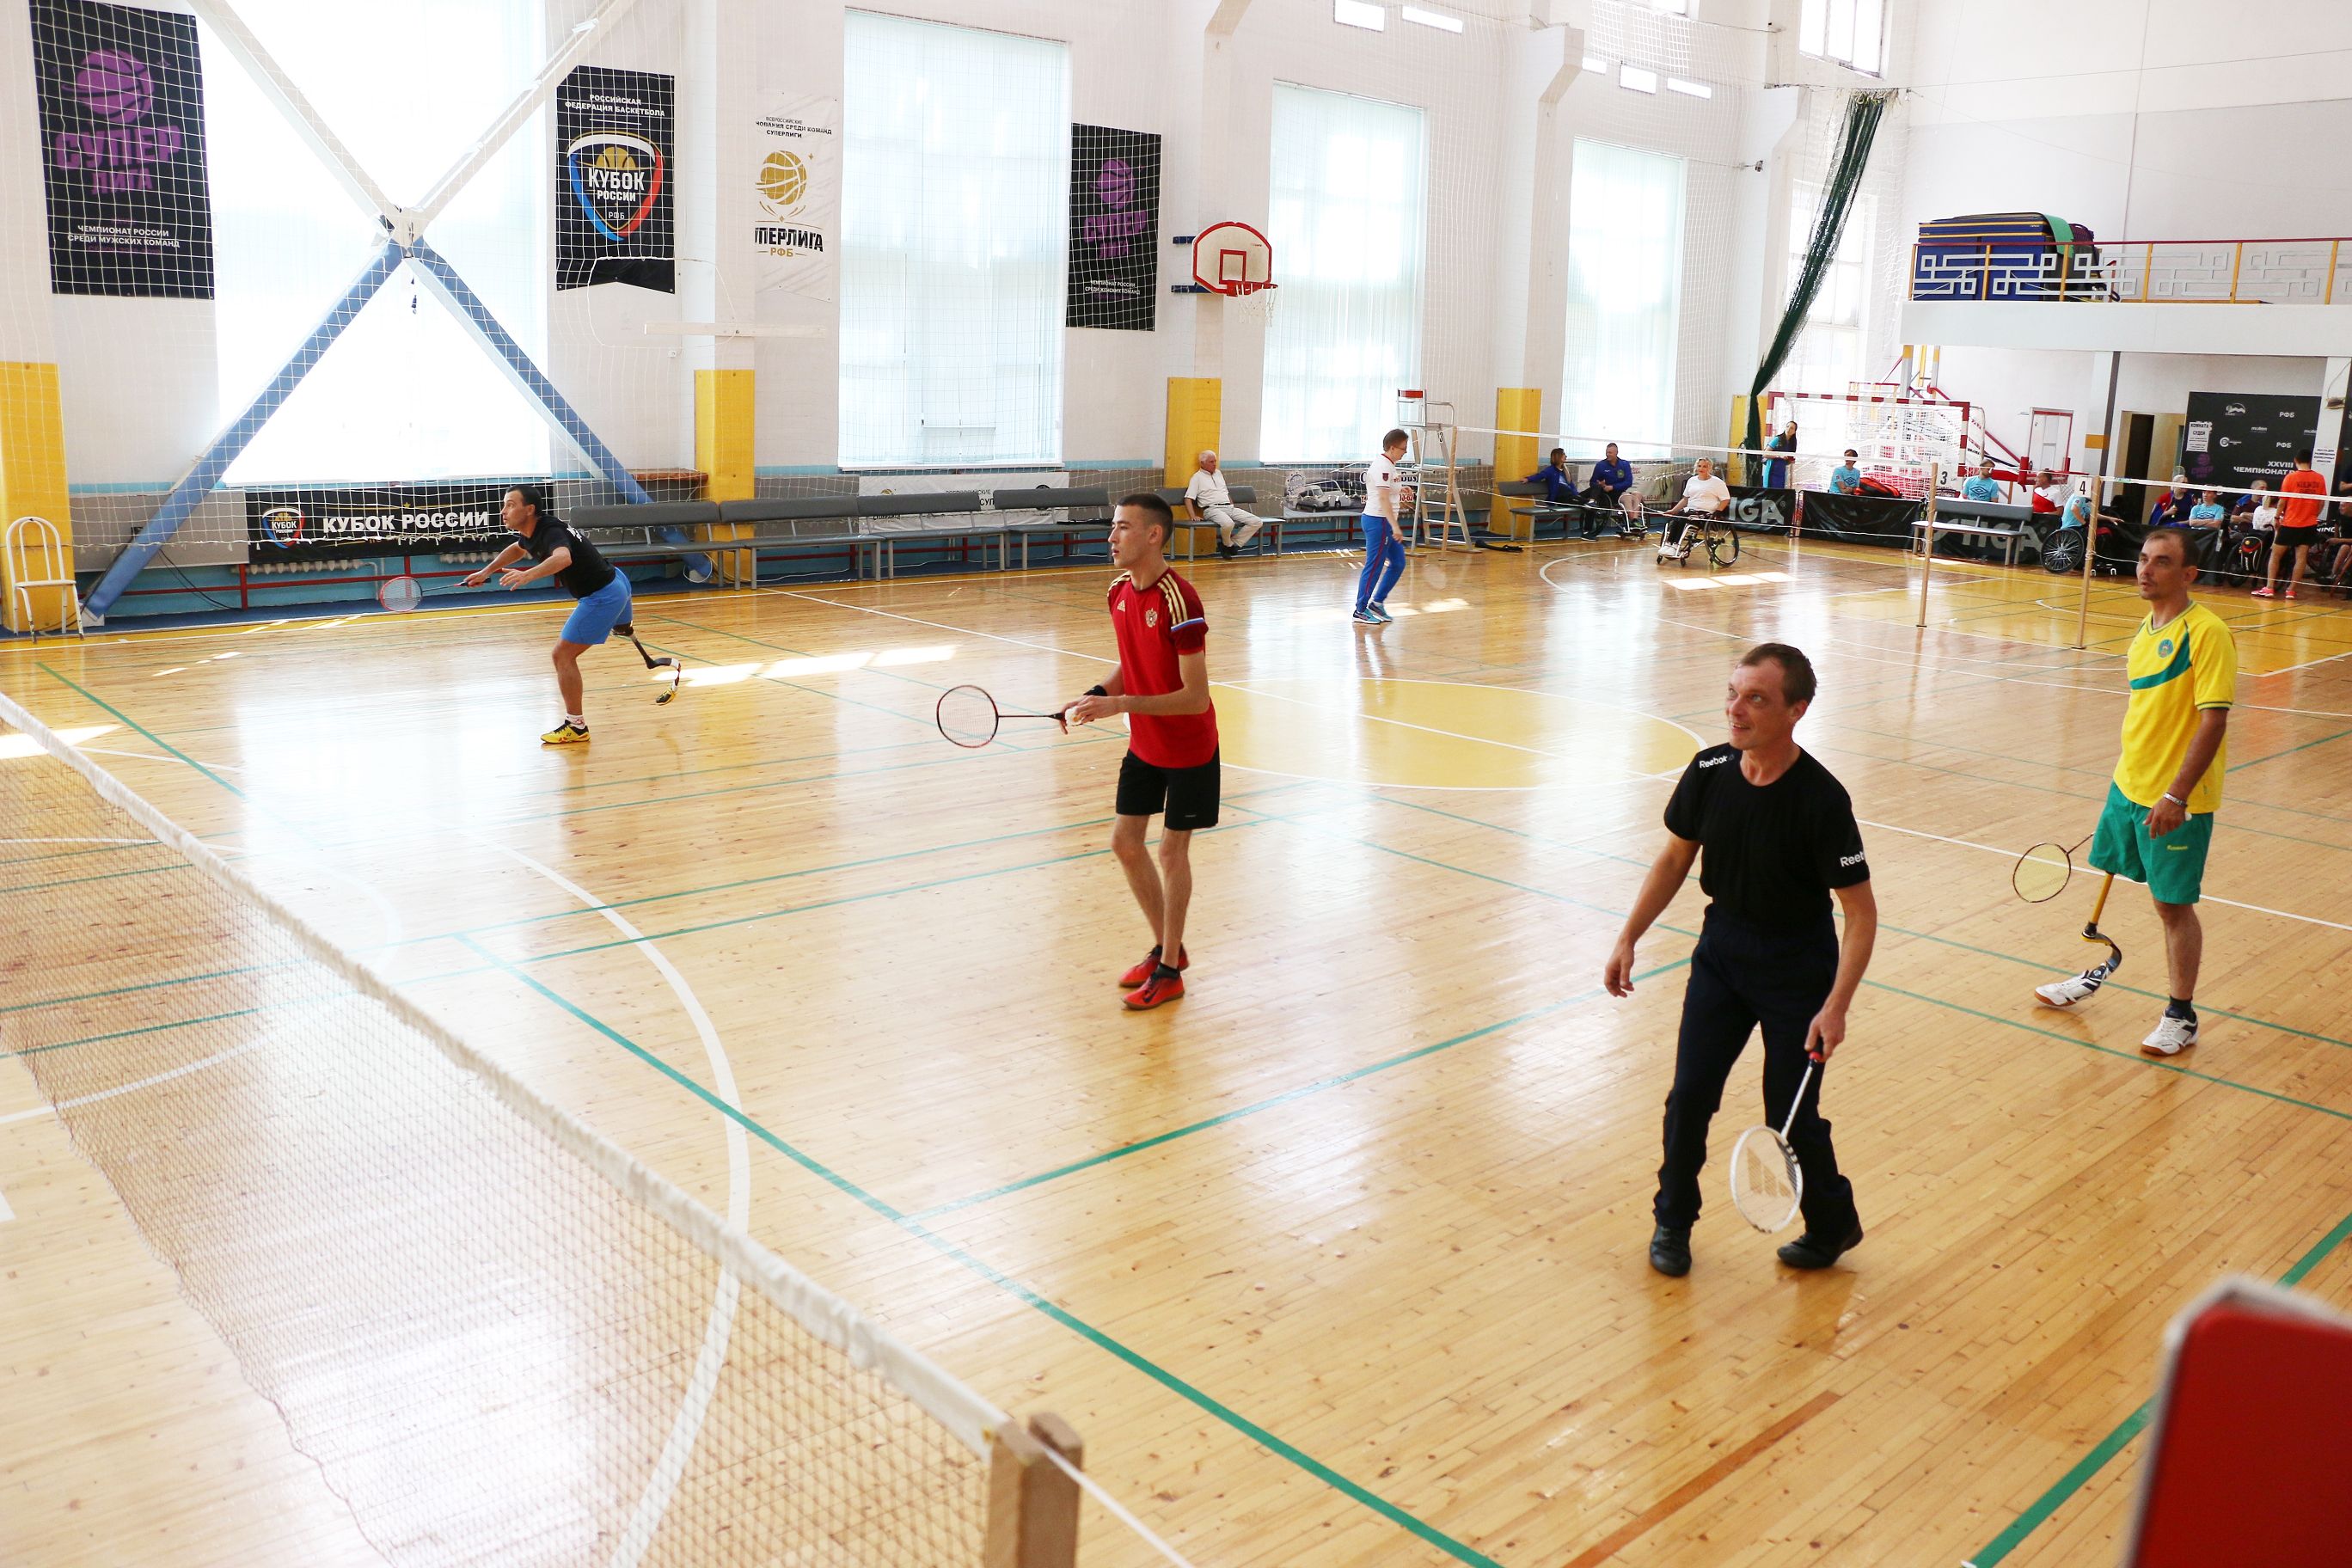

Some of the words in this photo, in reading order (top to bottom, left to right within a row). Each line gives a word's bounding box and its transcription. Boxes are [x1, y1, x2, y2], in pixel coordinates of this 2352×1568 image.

[589, 94, 641, 105] РОССИЙСКАЯ
[565, 101, 613, 112] ФЕДЕРАЦИЯ
[615, 106, 665, 117] БАСКЕТБОЛА
[55, 126, 181, 171] СУПЕР
[91, 168, 153, 195] ЛИГА
[588, 167, 645, 191] КУБОК
[597, 190, 636, 202] РОССИИ
[77, 224, 132, 235] ЧЕМПИОНАТ
[133, 228, 169, 236] РОССИИ
[68, 235, 97, 243] СРЕДИ
[99, 236, 143, 245] МУЖСКИХ
[144, 239, 181, 248] КОМАНД
[770, 247, 793, 257] РФБ
[2233, 466, 2288, 475] ЧЕМПИОНАТ
[2267, 460, 2294, 469] XXVIII
[1939, 470, 1948, 485] 3
[2078, 481, 2086, 495] 4
[272, 520, 297, 530] КУБОК
[322, 514, 396, 534] КУБОК
[402, 511, 489, 530] РОССИИ
[1699, 754, 1728, 769] Reebok
